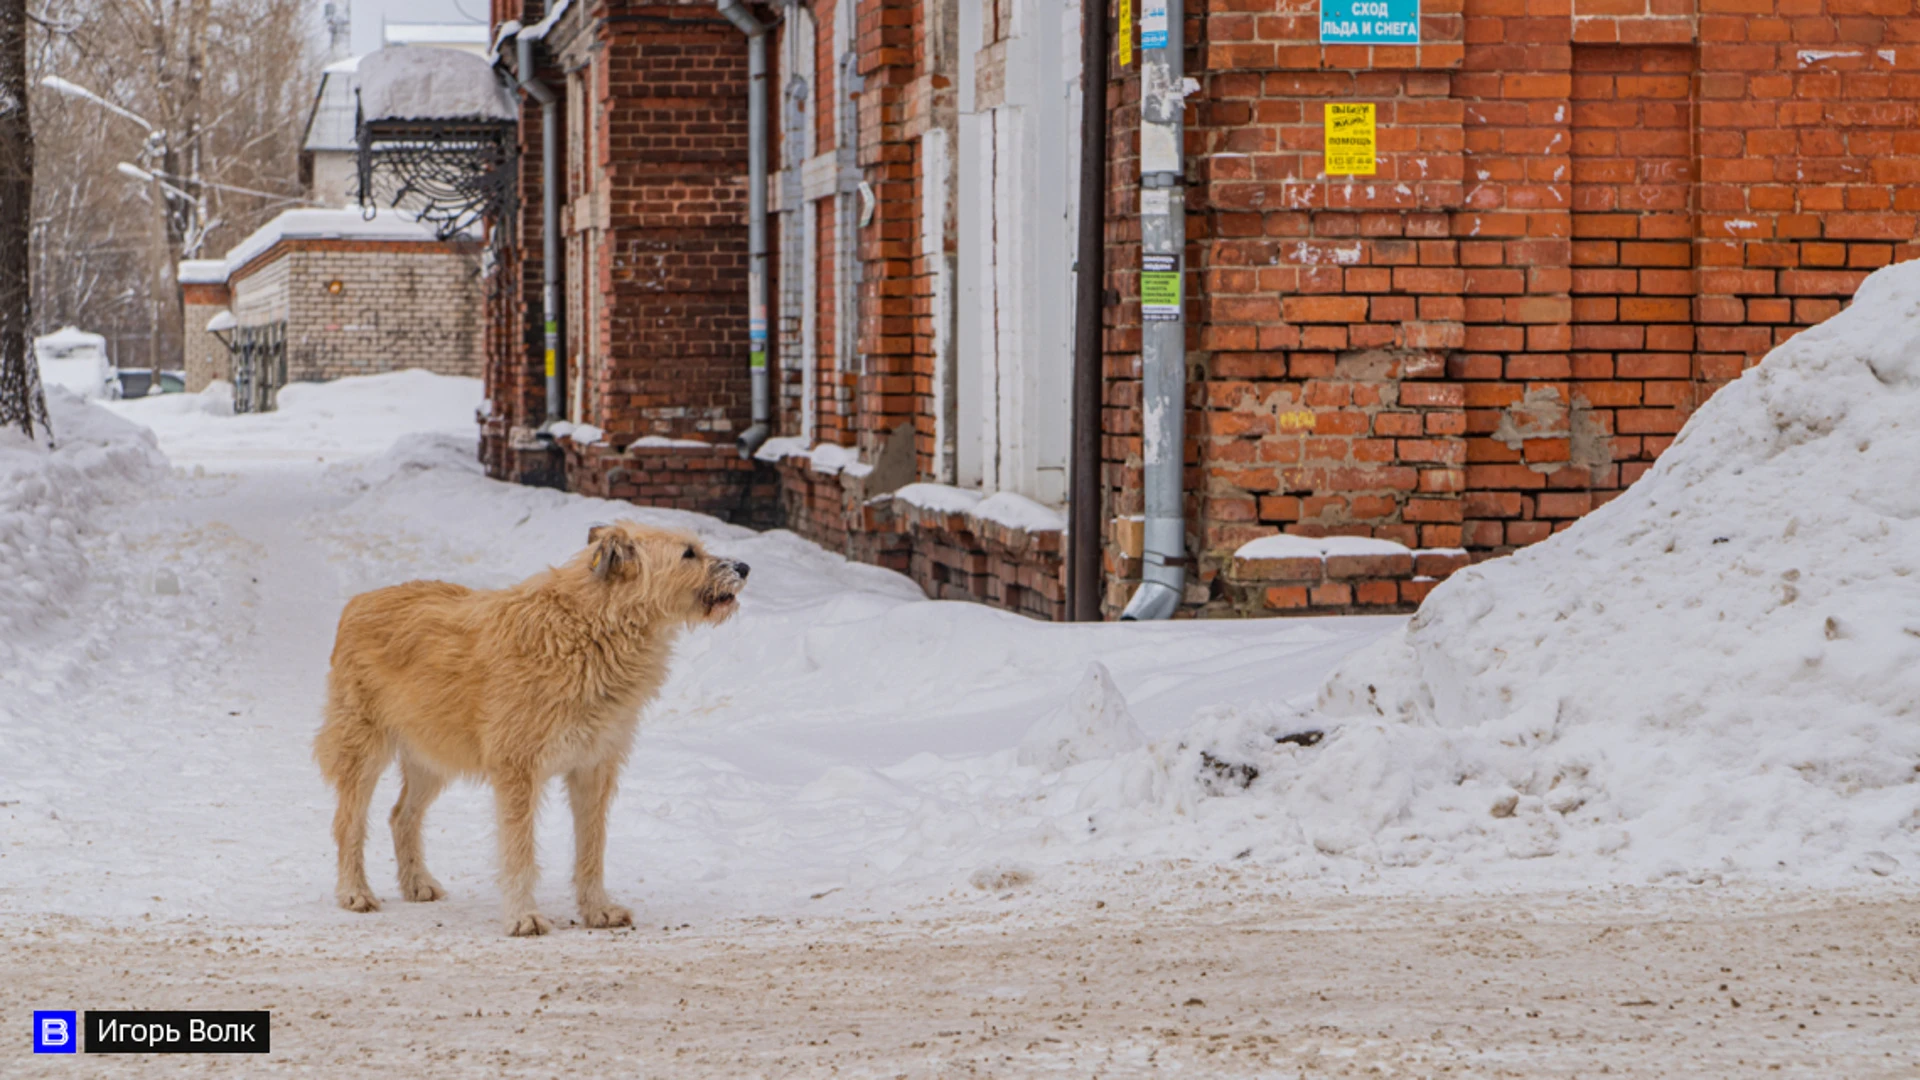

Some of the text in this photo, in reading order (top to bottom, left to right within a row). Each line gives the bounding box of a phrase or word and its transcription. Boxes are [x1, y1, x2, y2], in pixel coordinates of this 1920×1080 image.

[1352, 2, 1388, 18] СХОД
[1322, 22, 1416, 37] ЛЬДА И СНЕГА
[1328, 137, 1372, 146] ПОМОЩЬ
